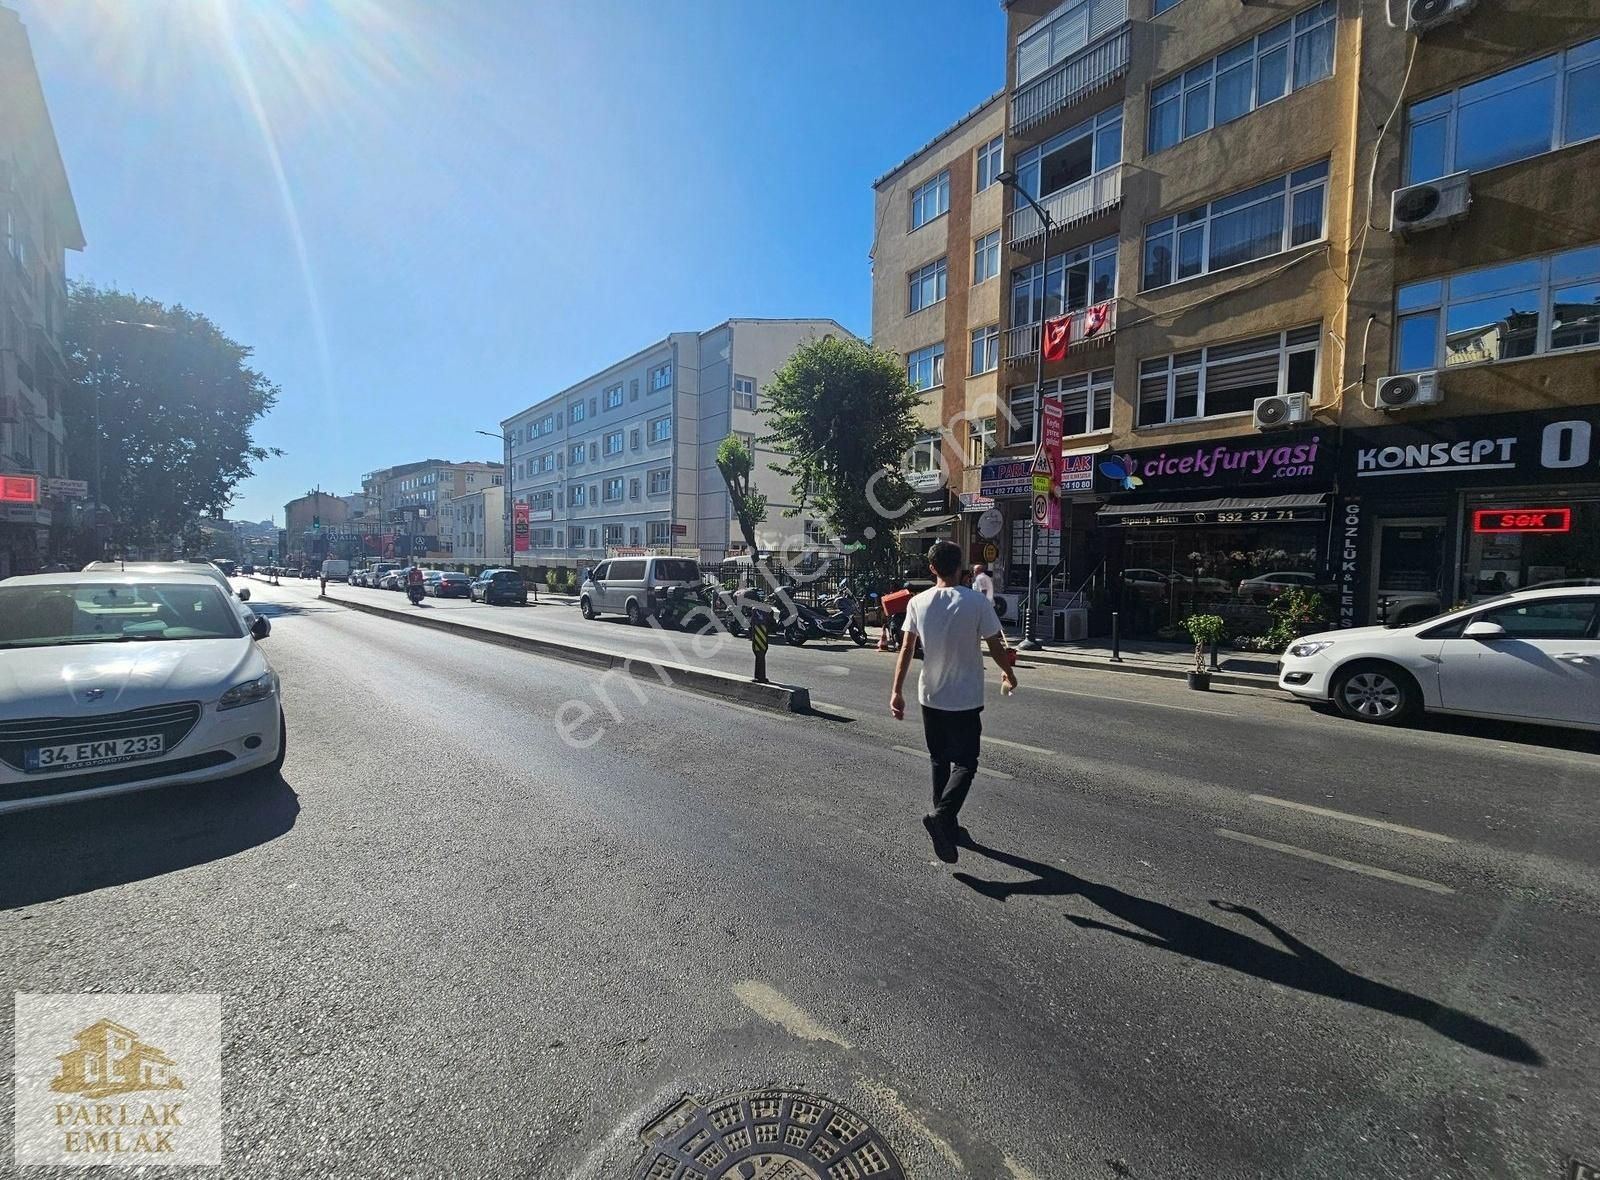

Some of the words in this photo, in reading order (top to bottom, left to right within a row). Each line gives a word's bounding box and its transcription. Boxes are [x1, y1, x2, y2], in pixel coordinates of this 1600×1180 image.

[1144, 436, 1320, 477] cicekfuryasi
[1357, 437, 1518, 470] KONSEPT
[1272, 465, 1314, 478] .com
[1036, 501, 1045, 514] 20
[1217, 512, 1243, 522] 532
[1250, 511, 1268, 521] 37
[1276, 510, 1295, 520] 71
[1500, 514, 1547, 527] SGK
[1342, 504, 1360, 571] GÖZLÜK
[40, 747, 69, 765] 34
[76, 741, 117, 761] EKN
[123, 736, 161, 754] 233
